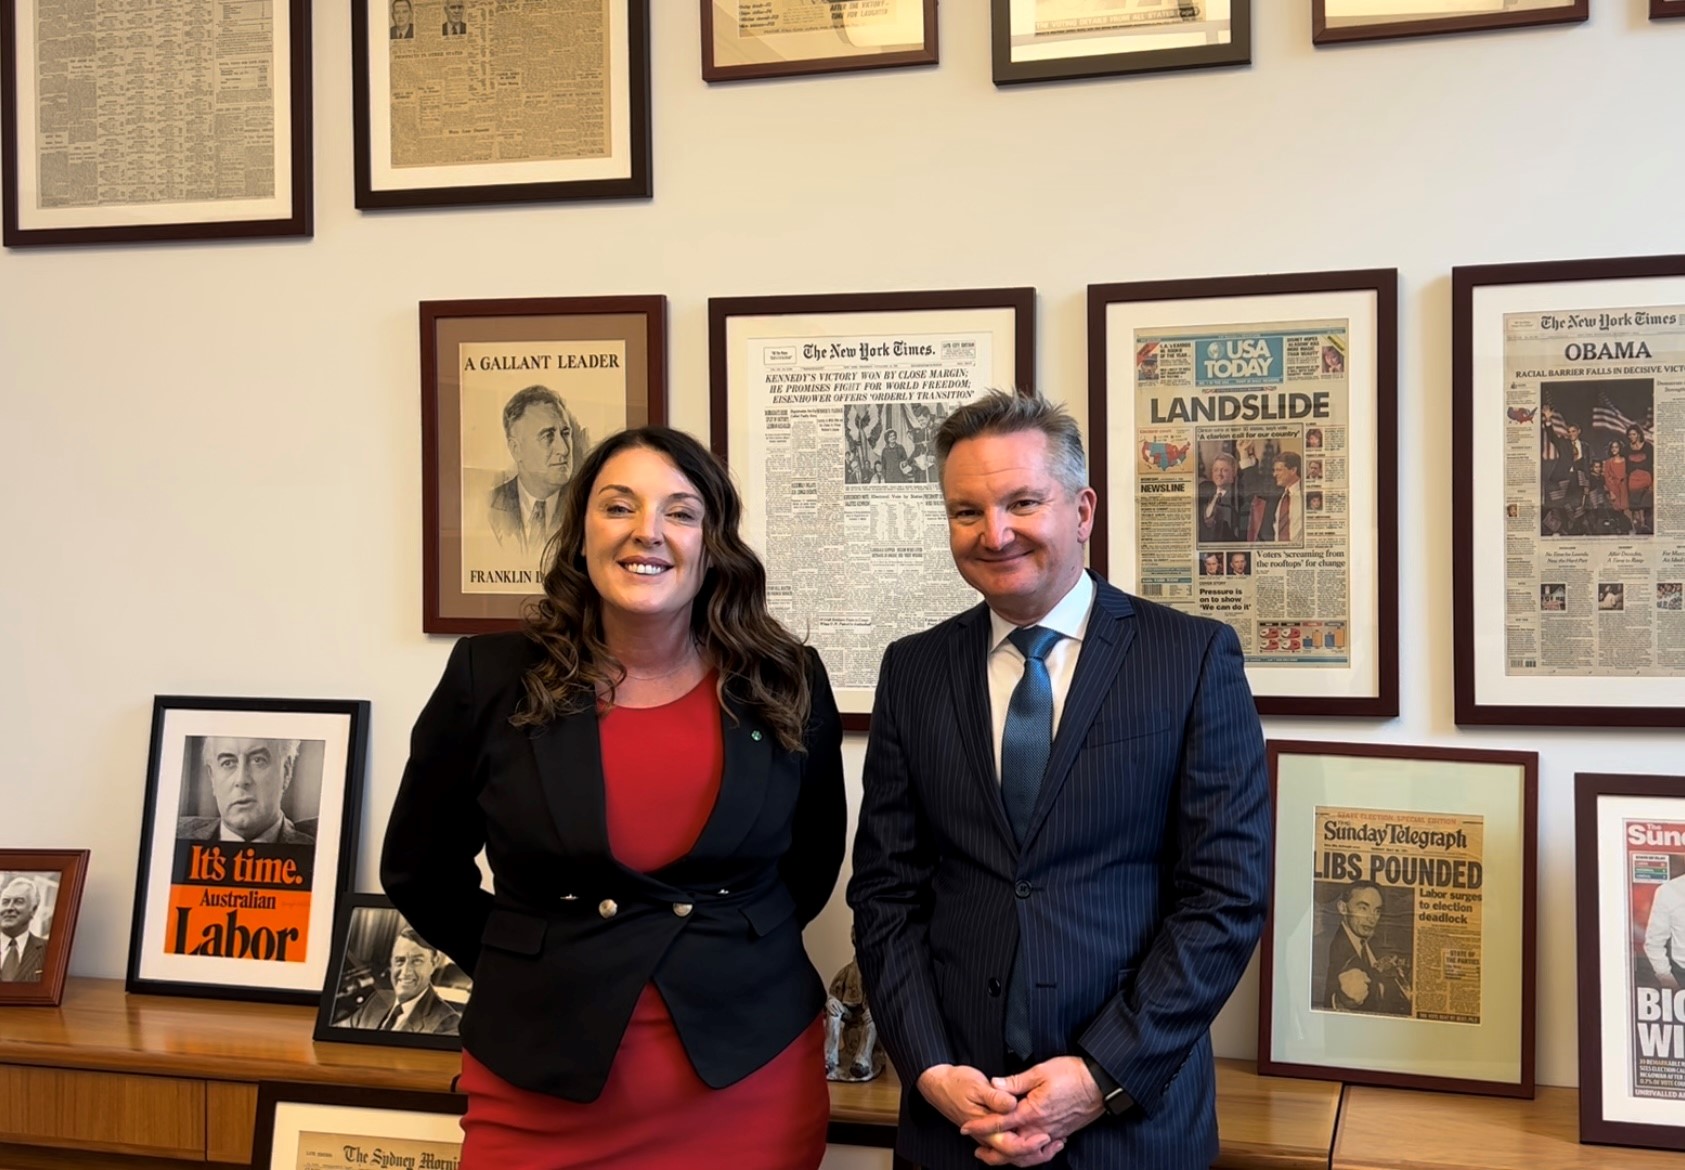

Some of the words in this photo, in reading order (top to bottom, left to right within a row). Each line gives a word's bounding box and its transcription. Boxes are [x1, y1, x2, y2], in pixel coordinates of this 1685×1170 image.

[1541, 315, 1566, 331] The
[1567, 314, 1597, 329] New
[1599, 313, 1633, 331] York
[1635, 311, 1677, 326] Times
[802, 343, 828, 361] The
[829, 342, 857, 359] New
[859, 341, 890, 361] York
[893, 340, 936, 356] Times.
[1226, 339, 1271, 359] USA
[1564, 341, 1652, 362] OBAMA
[464, 357, 476, 371] A
[479, 354, 552, 370] GALLANT
[557, 353, 620, 369] LEADER
[1204, 357, 1274, 379] TODAY
[765, 372, 817, 384] KENNEDY'S
[819, 371, 858, 382] VICTORY
[860, 370, 881, 381] WON
[883, 370, 897, 380] BY
[898, 369, 928, 379] CLOSE
[929, 368, 969, 378] MARGIN;
[1516, 370, 1547, 378] RACIAL
[1548, 368, 1585, 377] BARRIER
[1613, 367, 1622, 375] IN
[1623, 366, 1662, 374] DECISIVE
[1664, 365, 1685, 373] VICT
[769, 384, 783, 394] HE
[786, 383, 831, 393] PROMISES
[833, 382, 861, 392] FIGHT
[863, 381, 883, 391] FOR
[885, 380, 920, 390] WORLD
[922, 379, 971, 389] FREEDOM;
[772, 393, 832, 404] EISENHOWER
[833, 393, 868, 403] OFFERS
[1151, 391, 1330, 424] LANDSLIDE
[1141, 483, 1185, 493] NEWSLINE
[1257, 551, 1282, 559] Voters
[1325, 549, 1344, 558] from
[1257, 560, 1269, 568] the
[1305, 559, 1317, 567] for
[1318, 559, 1345, 569] change
[470, 570, 532, 583] FRANKLIN
[1199, 588, 1234, 596] Pressure
[1359, 812, 1394, 822] ELECTION
[1427, 816, 1457, 825] EDITION
[1324, 820, 1388, 846] Sunday
[1385, 823, 1468, 851] Telegraph
[1628, 824, 1685, 846] Sun
[189, 845, 226, 882] It's
[233, 848, 303, 885] time.
[1314, 850, 1363, 881] LIBS
[1370, 854, 1483, 890] POUNDED
[199, 888, 277, 909] Australian
[1419, 888, 1447, 900] Labor
[1449, 892, 1482, 902] surges
[1419, 900, 1431, 910] to
[1432, 901, 1473, 913] election
[1418, 912, 1468, 925] deadlock
[174, 906, 299, 962] Labor
[1635, 1089, 1678, 1098] UNRIVALLED
[343, 1145, 369, 1164] The
[371, 1148, 416, 1170] Sydney
[419, 1152, 461, 1170] Morni
